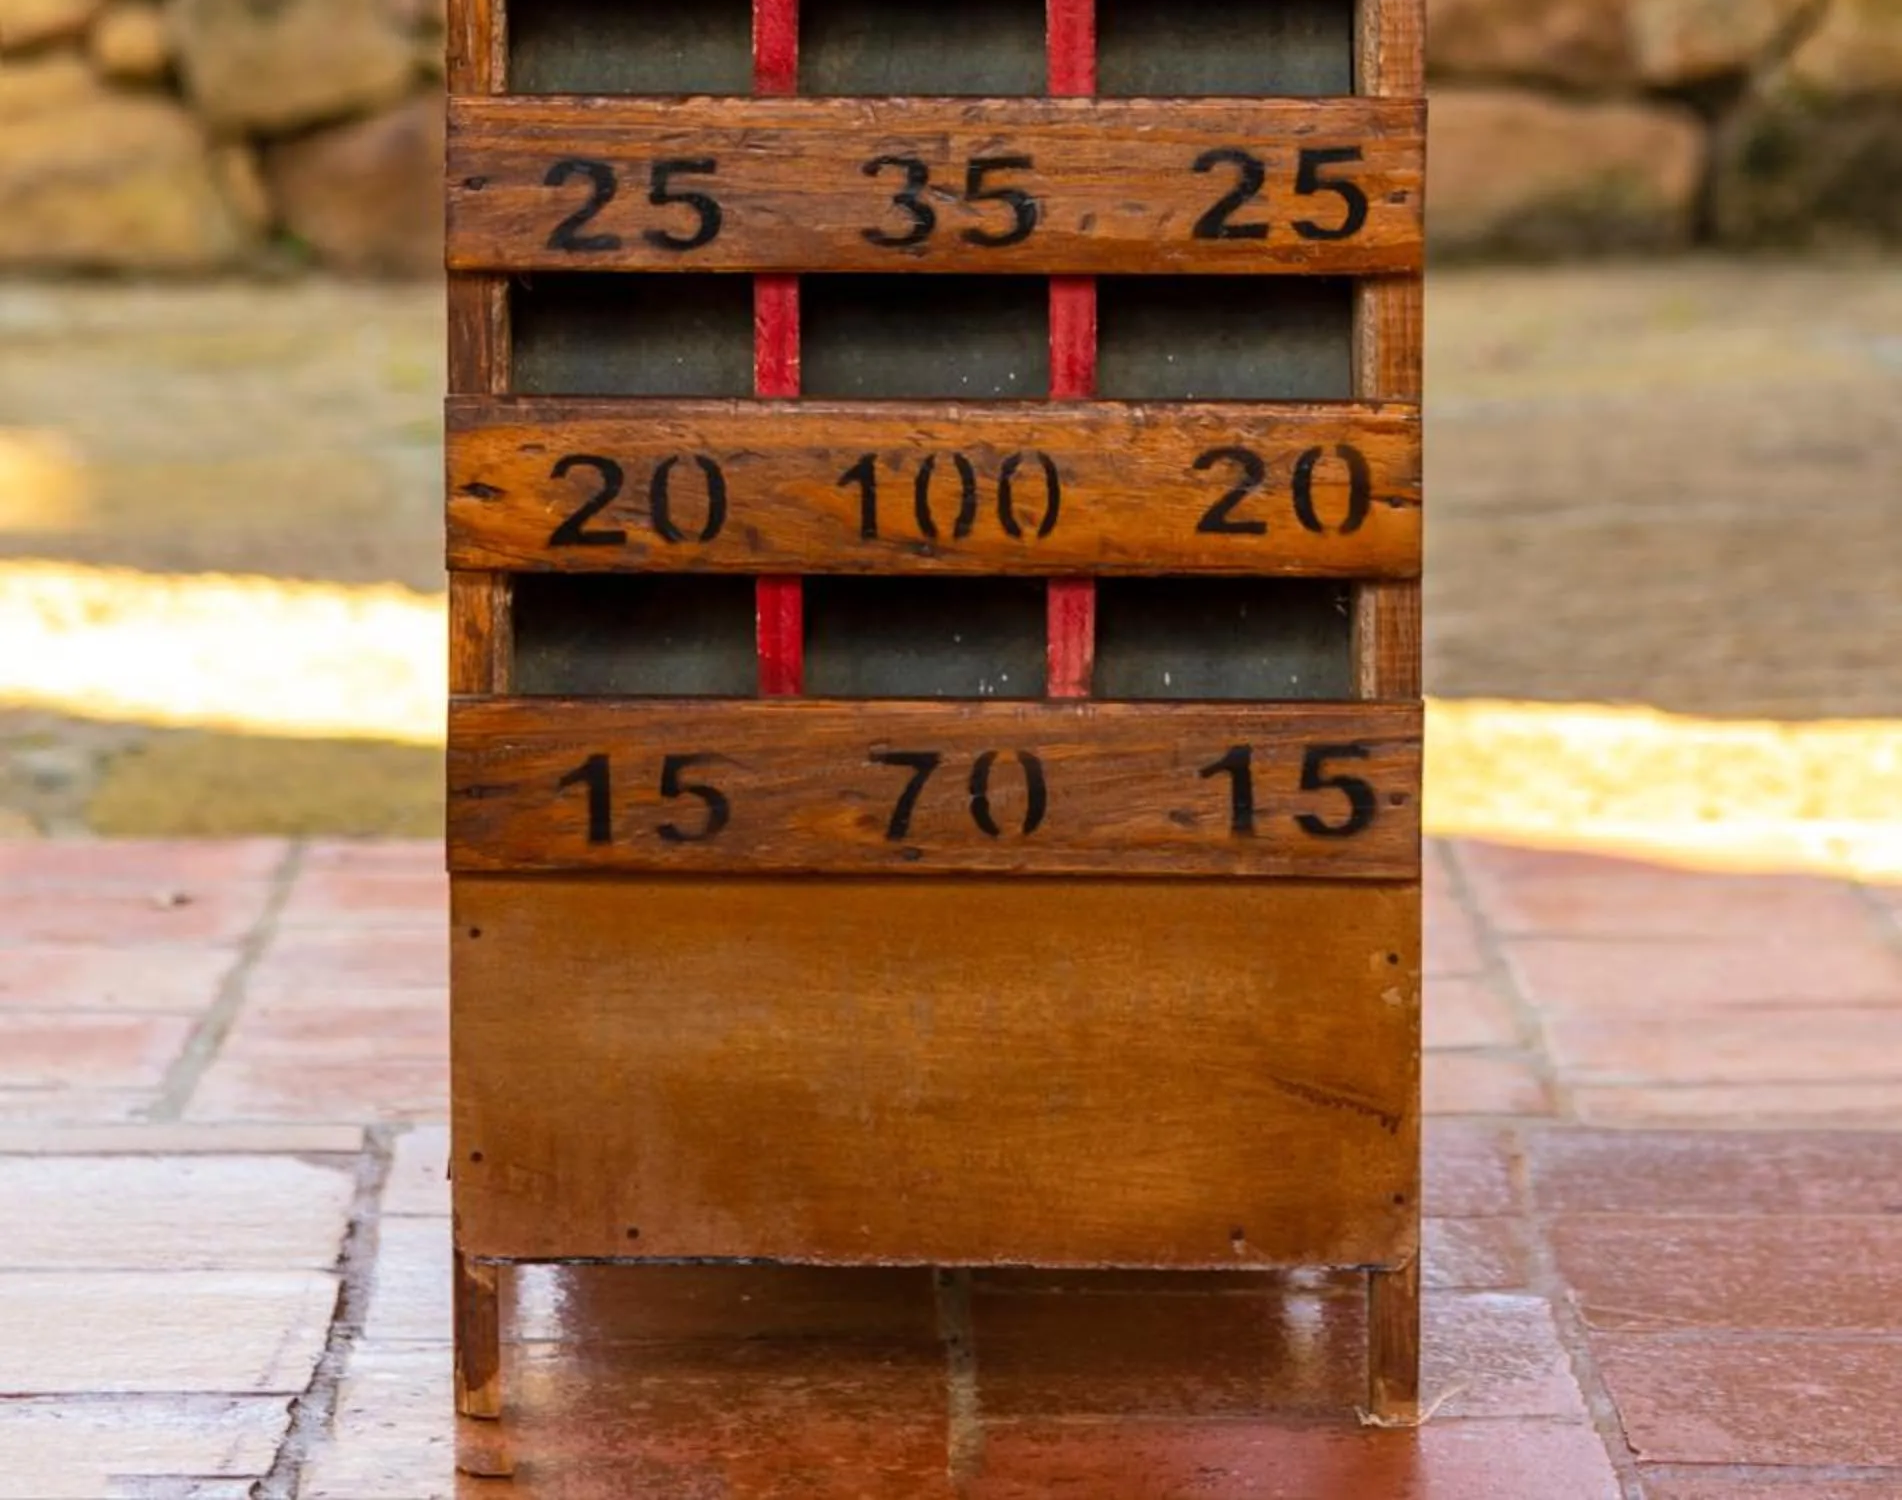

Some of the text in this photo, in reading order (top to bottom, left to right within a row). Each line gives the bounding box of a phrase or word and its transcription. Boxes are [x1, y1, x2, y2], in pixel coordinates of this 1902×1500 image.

[543, 145, 1370, 253] 25 35 25
[547, 442, 1374, 548] 20 100 20
[556, 742, 1377, 846] 15 70 15
